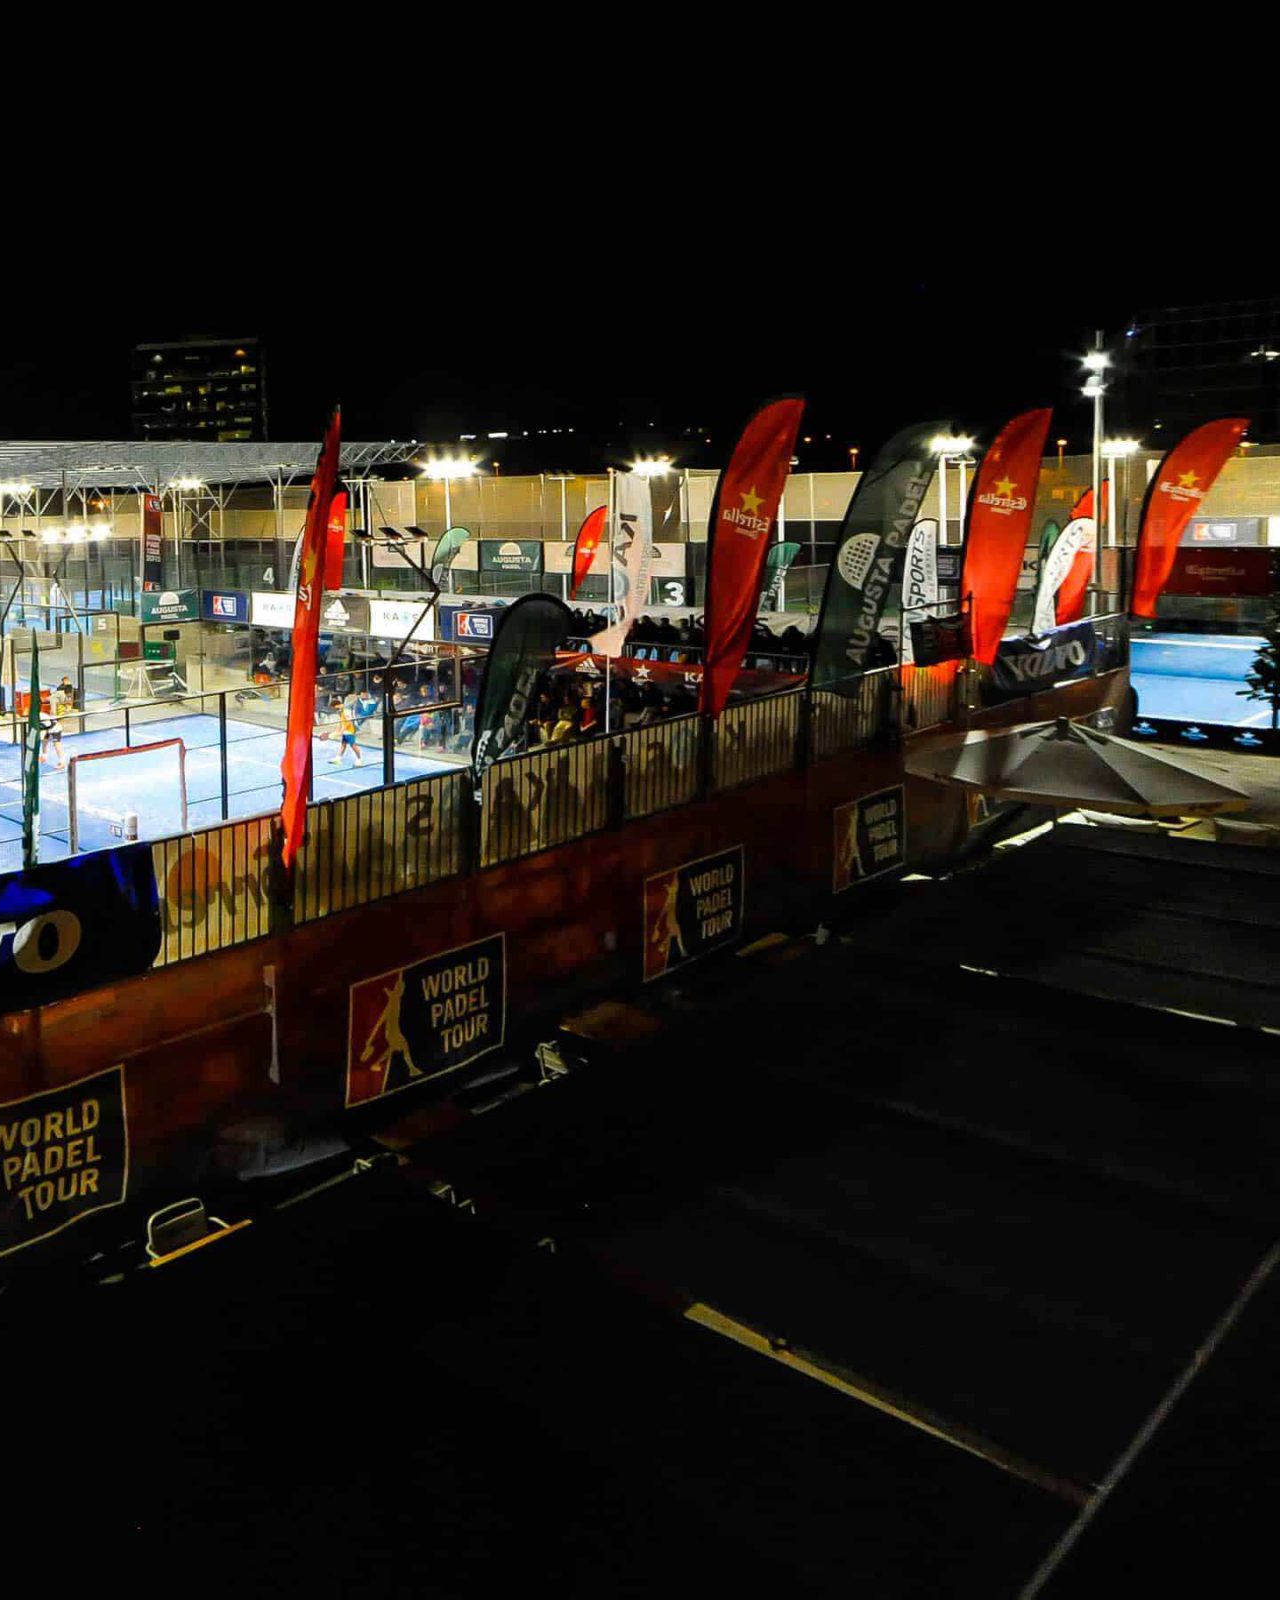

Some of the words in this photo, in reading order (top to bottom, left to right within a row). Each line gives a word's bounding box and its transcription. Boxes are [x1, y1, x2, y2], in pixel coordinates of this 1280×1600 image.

[262, 567, 275, 585] 4
[846, 556, 895, 666] AUGUSTA
[886, 470, 931, 549] PADEL
[150, 604, 189, 615] AUGUSTA
[664, 582, 684, 607] 3
[97, 617, 108, 631] 5
[689, 863, 734, 897] WORLD
[696, 888, 733, 920] PADEL
[701, 910, 734, 940] TOUR
[421, 957, 490, 1001] WORLD
[430, 985, 491, 1029] PADEL
[440, 1013, 489, 1054] TOUR
[2, 1134, 103, 1191] PADEL
[18, 1167, 100, 1221] TOUR
